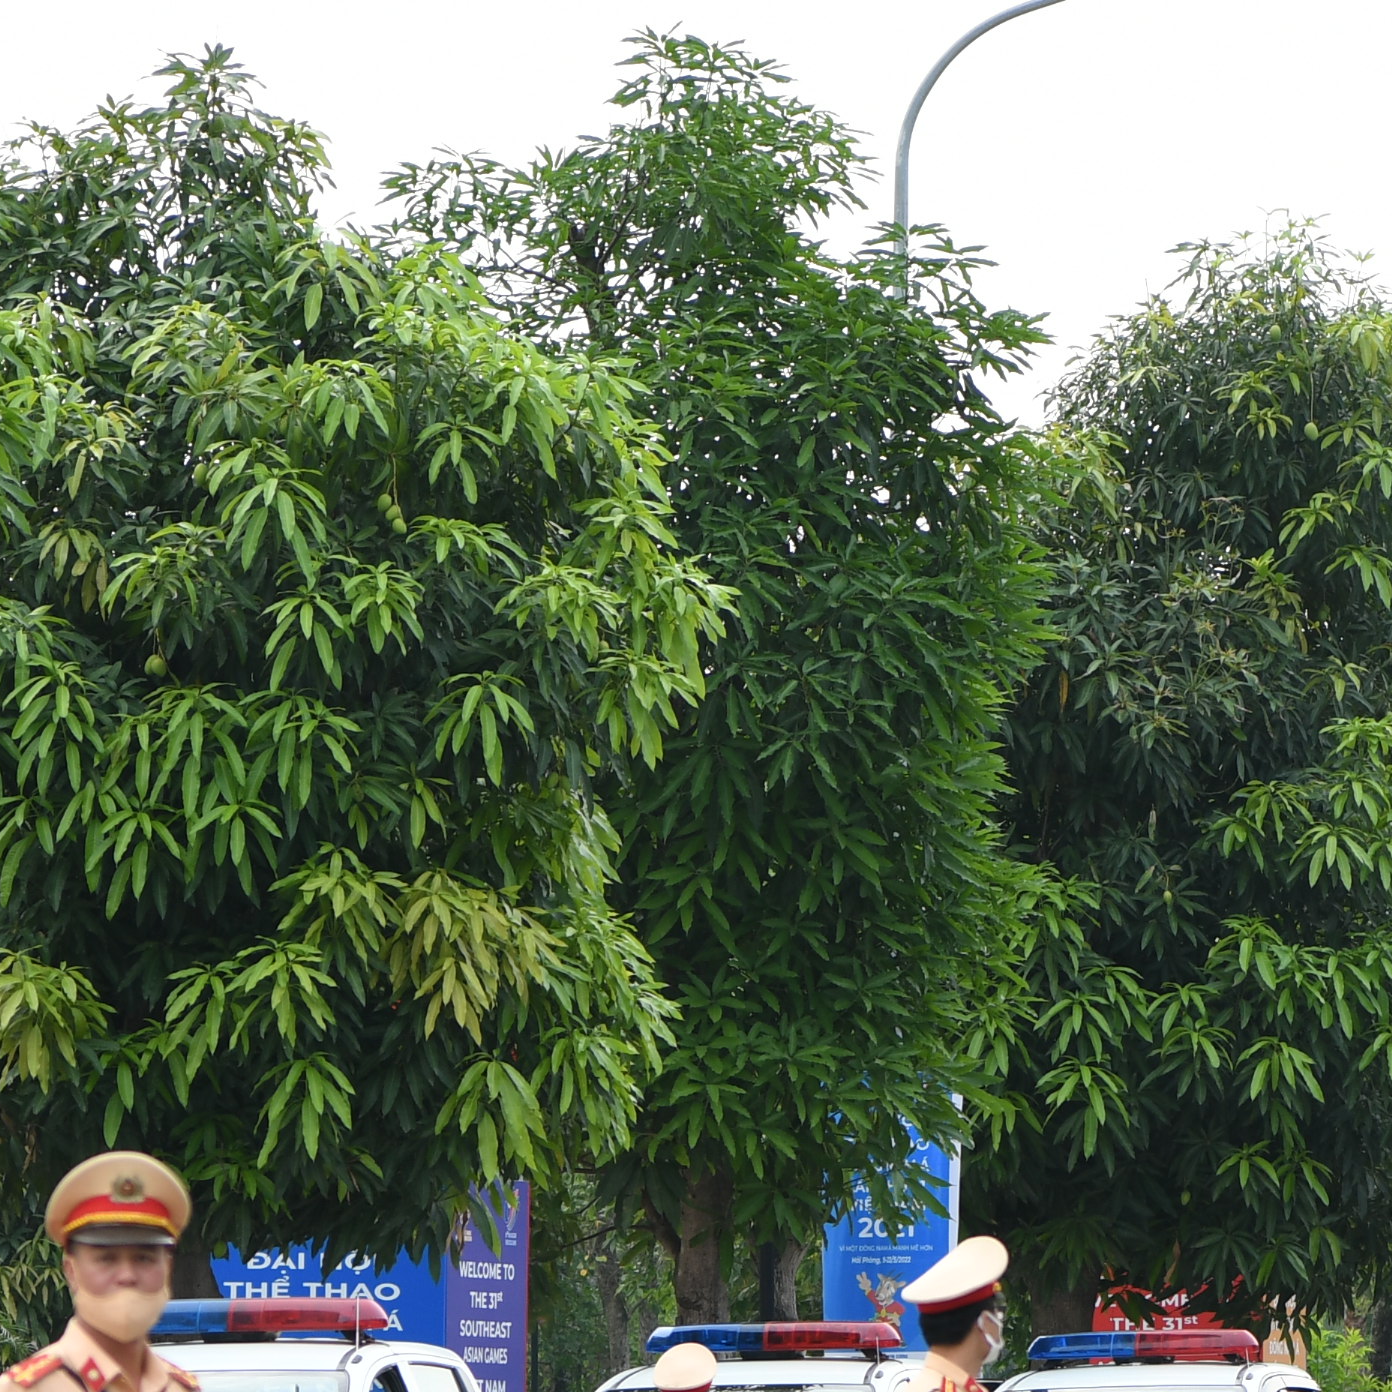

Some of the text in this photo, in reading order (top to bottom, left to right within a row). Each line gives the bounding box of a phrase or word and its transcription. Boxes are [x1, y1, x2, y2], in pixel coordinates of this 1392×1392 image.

[459, 1261, 515, 1281] WELCOME TO
[223, 1275, 401, 1301] THỂ THAO
[470, 1291, 504, 1309] THE 31st
[459, 1319, 512, 1338] SOUTHEAST
[1162, 1315, 1199, 1331] 31st
[463, 1346, 508, 1364] ASIAN GAMES
